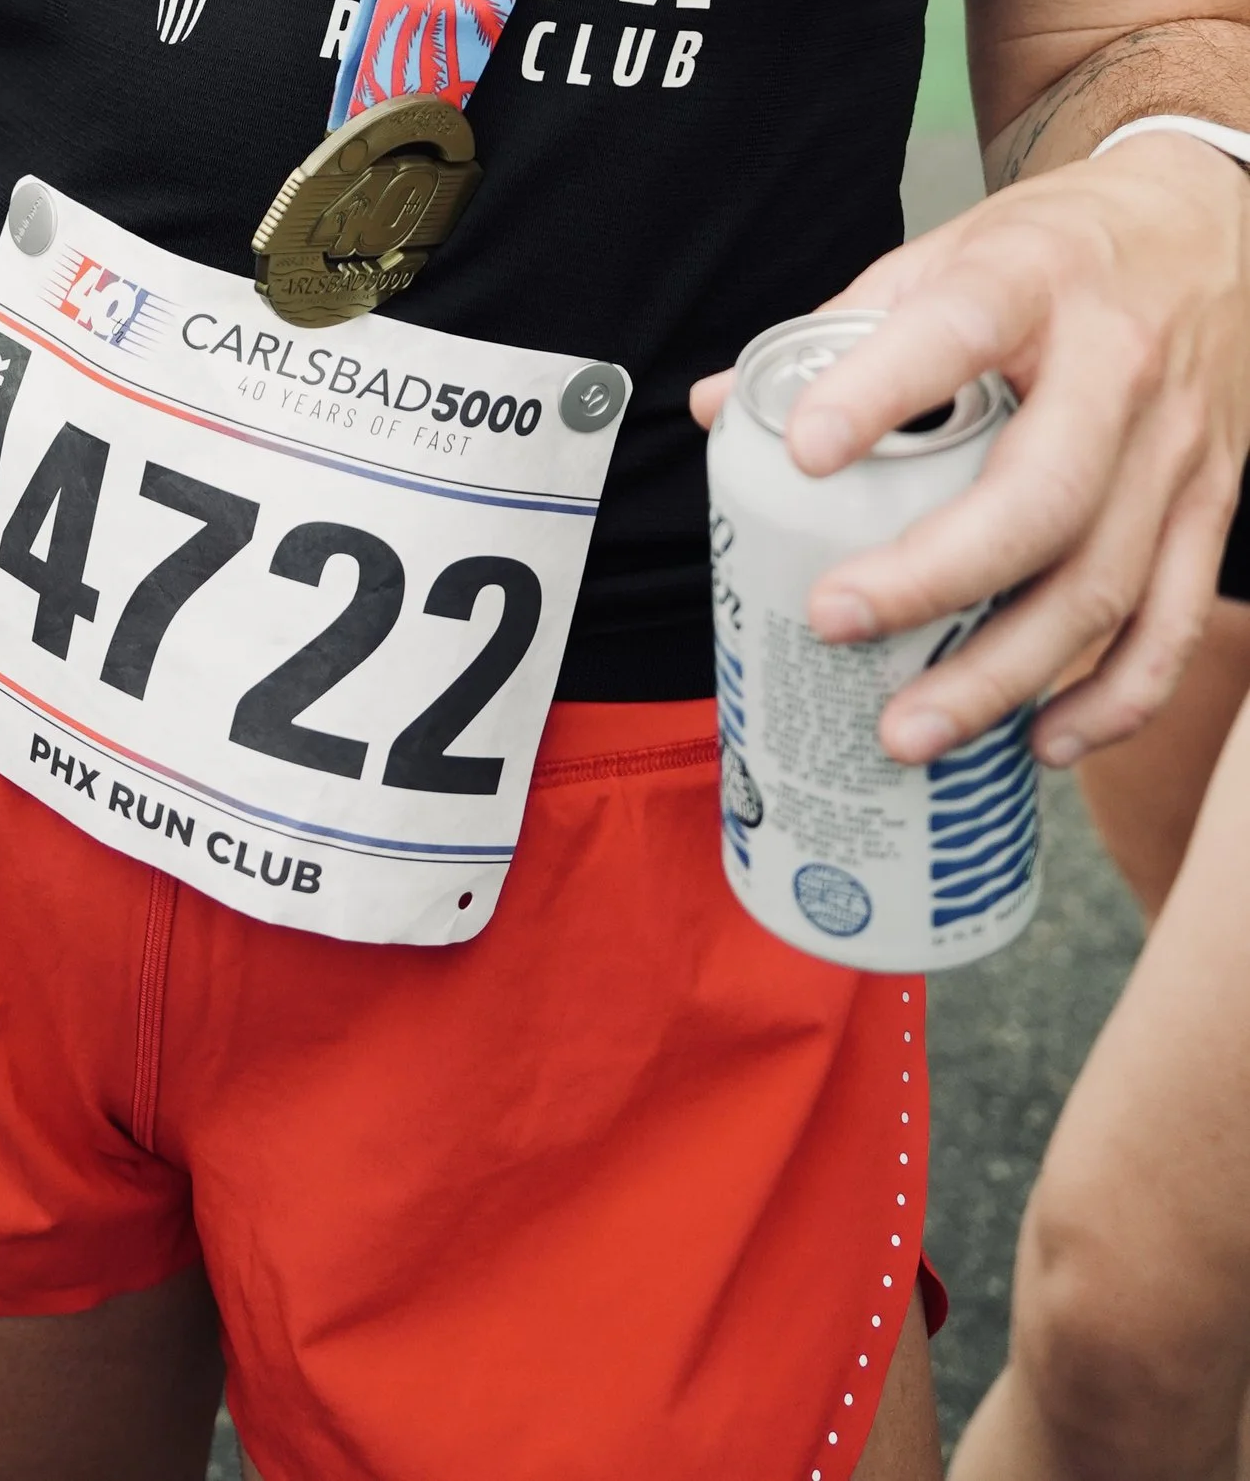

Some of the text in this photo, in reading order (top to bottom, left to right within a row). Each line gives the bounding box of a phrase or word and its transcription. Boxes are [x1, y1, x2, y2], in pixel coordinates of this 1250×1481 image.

[521, 21, 703, 88] CLUB
[181, 313, 543, 436] CARLSBAD5000
[237, 375, 472, 457] 40 YEARS OF FAST
[30, 733, 322, 894] PHX RUN CLUB
